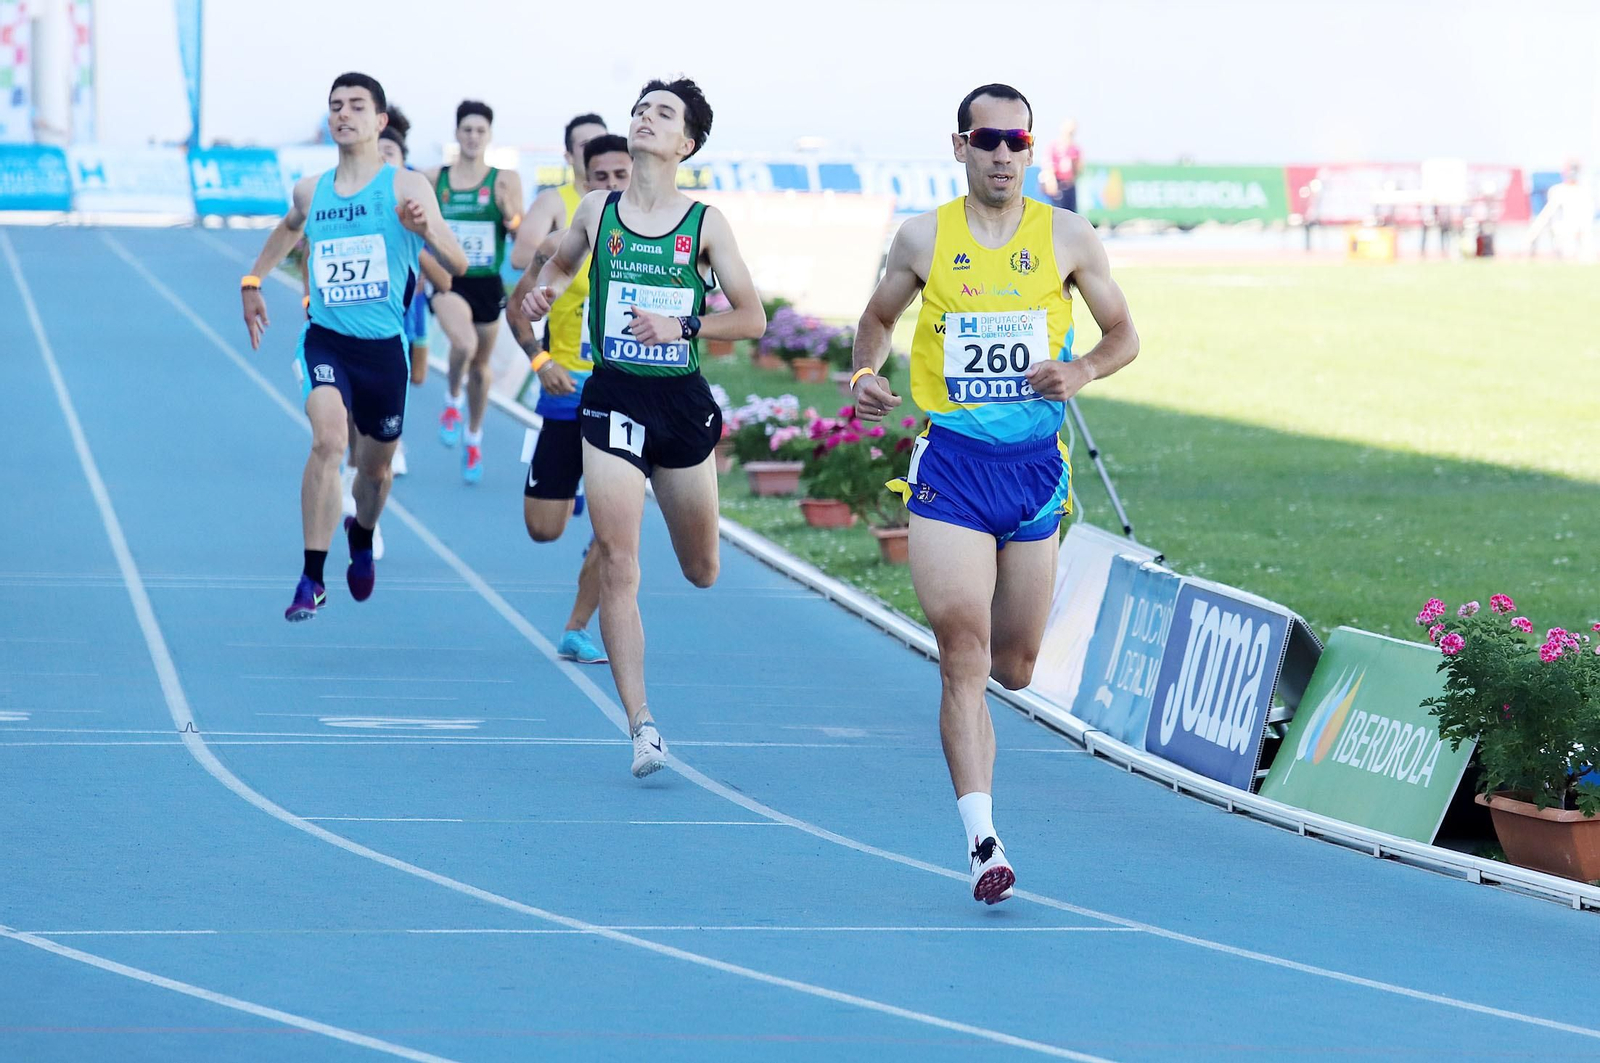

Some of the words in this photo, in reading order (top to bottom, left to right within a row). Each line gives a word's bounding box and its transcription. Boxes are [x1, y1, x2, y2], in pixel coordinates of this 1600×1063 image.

[315, 203, 367, 222] nerja
[630, 242, 663, 255] Joma
[326, 258, 371, 284] 257
[610, 259, 667, 275] VILLARREAL
[621, 287, 637, 302] H
[960, 317, 977, 333] H
[980, 325, 993, 333] DE
[996, 323, 1033, 332] HUELVA
[610, 340, 680, 362] Joma
[964, 343, 1030, 374] 260
[954, 379, 1035, 402] Joma
[620, 421, 633, 446] 1
[1160, 598, 1271, 756] Joma
[1332, 708, 1443, 788] IBERDROLA
